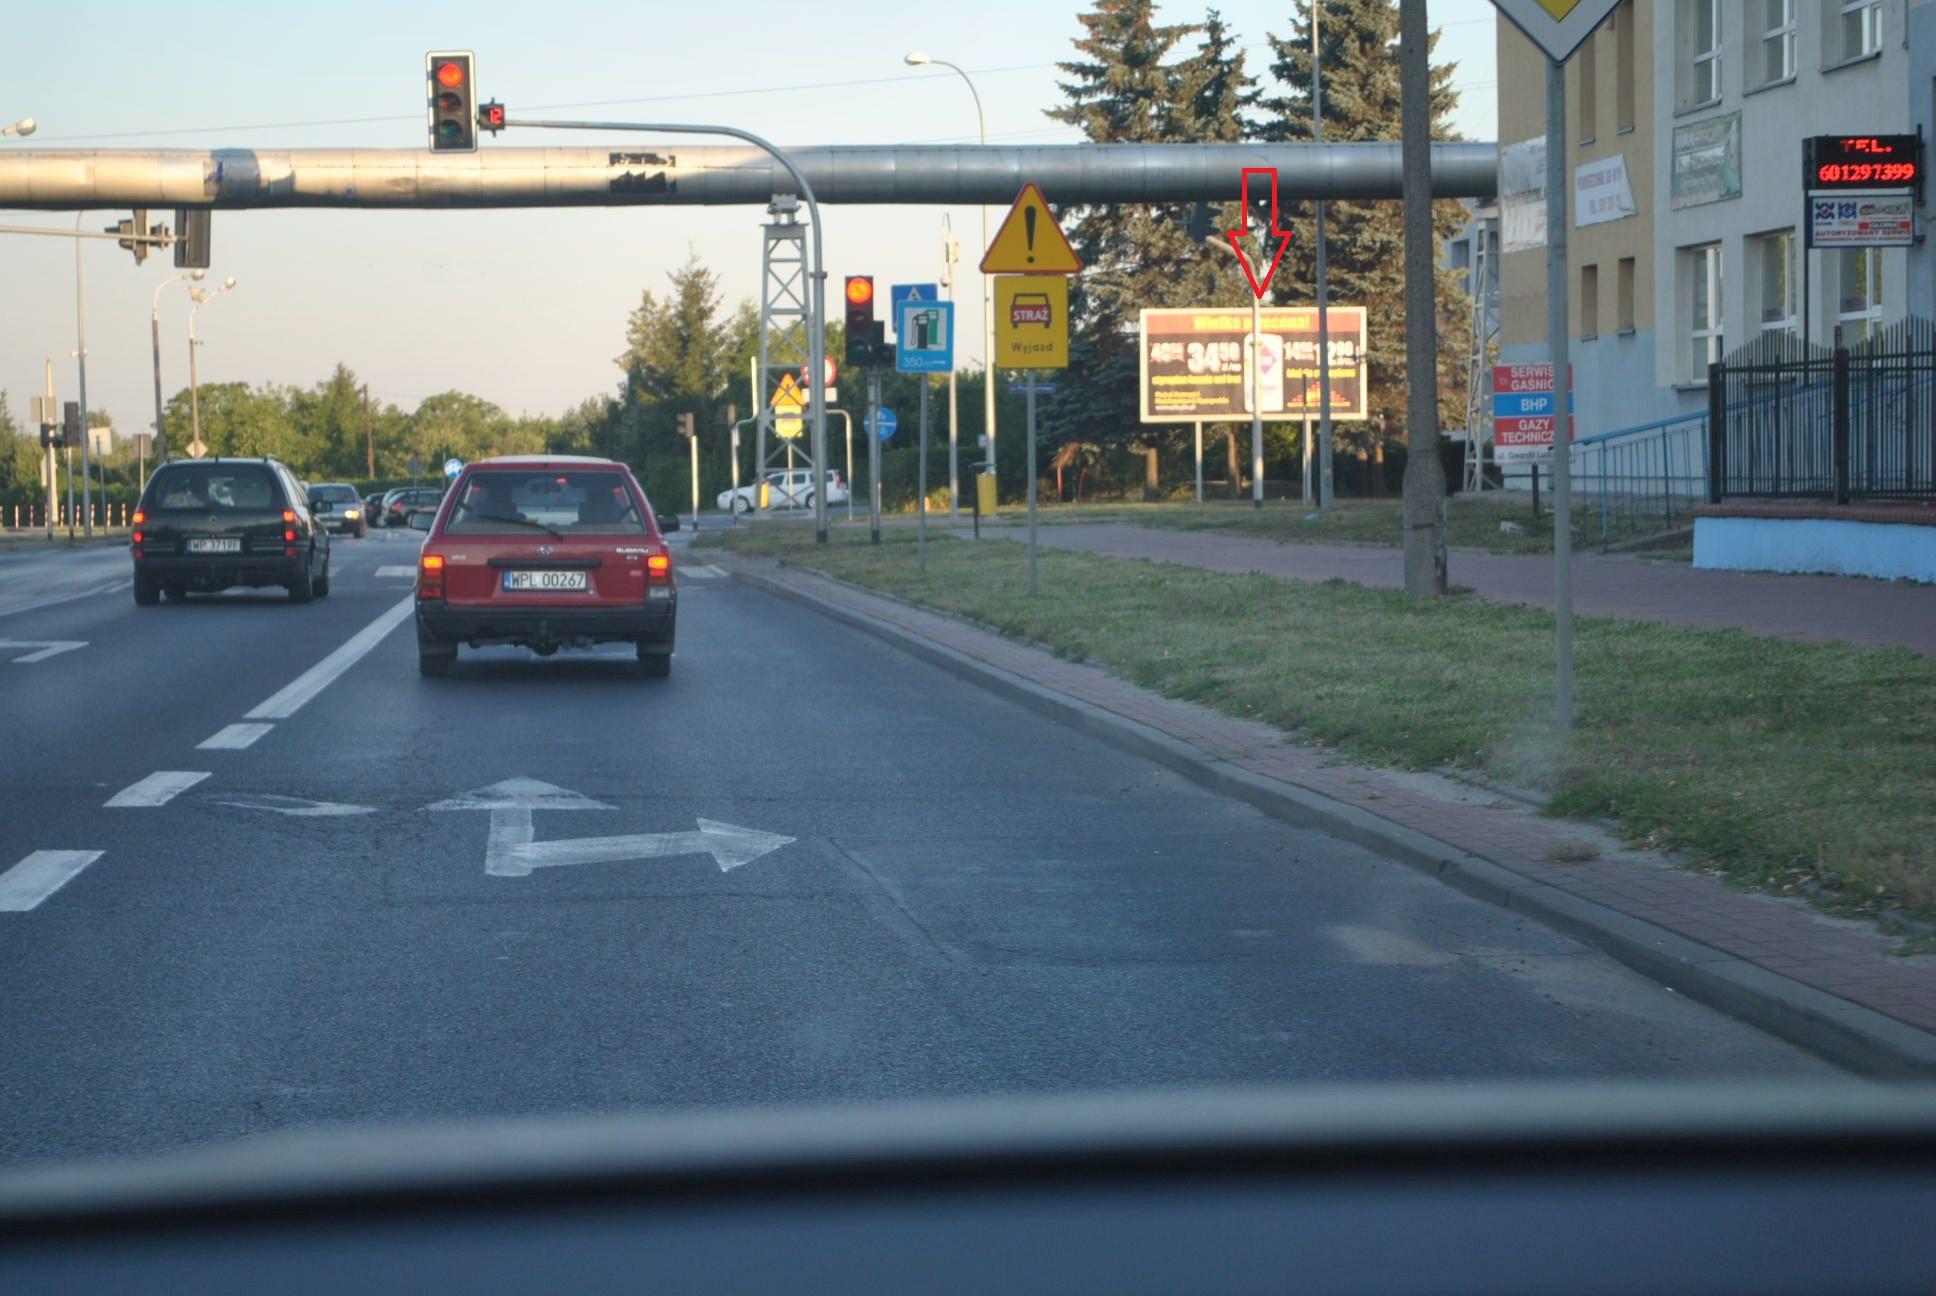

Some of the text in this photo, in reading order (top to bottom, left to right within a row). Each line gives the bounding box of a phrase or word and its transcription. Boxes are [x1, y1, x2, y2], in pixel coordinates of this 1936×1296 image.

[1819, 164, 1915, 181] 601297399
[1014, 307, 1049, 321] STRAŻ
[1012, 342, 1053, 354] Wyjazd
[1521, 398, 1548, 411] BHP
[1519, 418, 1550, 431] GAZY
[1502, 430, 1555, 443] TECHNICZ
[511, 571, 584, 587] WPL 00267
